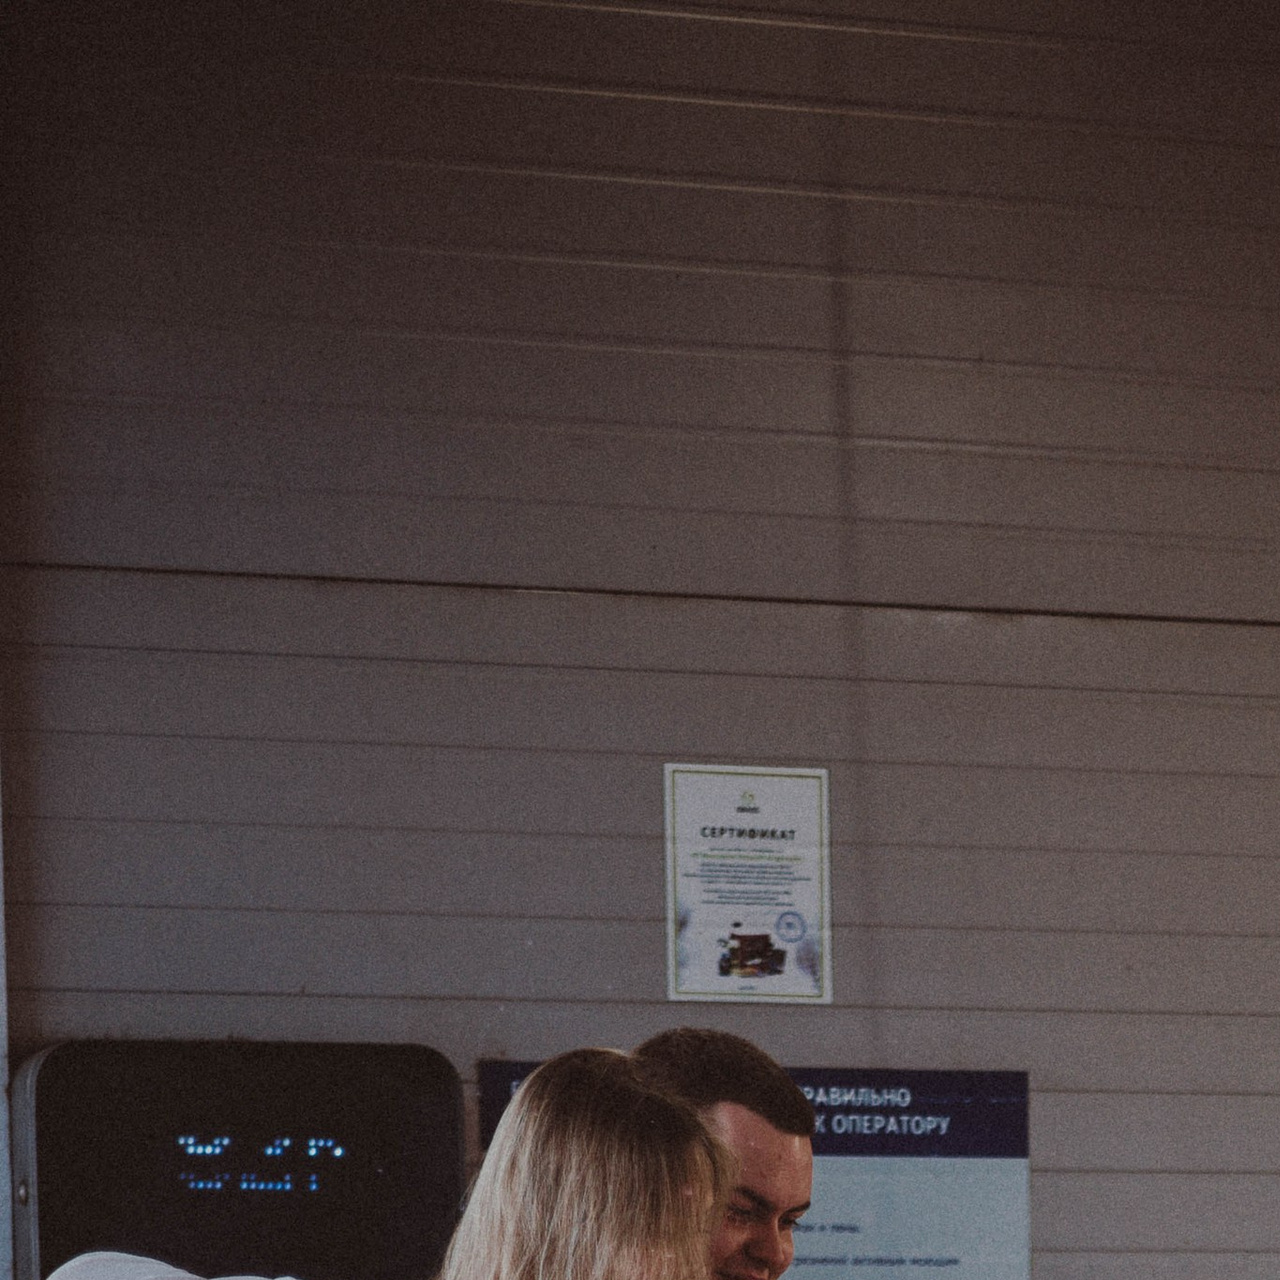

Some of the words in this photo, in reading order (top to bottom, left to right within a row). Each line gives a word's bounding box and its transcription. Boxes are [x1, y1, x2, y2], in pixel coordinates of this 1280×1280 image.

[701, 826, 796, 840] СЕРТИФИКАТ
[802, 1086, 912, 1107] РАВИЛЬНО
[831, 1115, 950, 1135] ОПЕРАТОРУ
